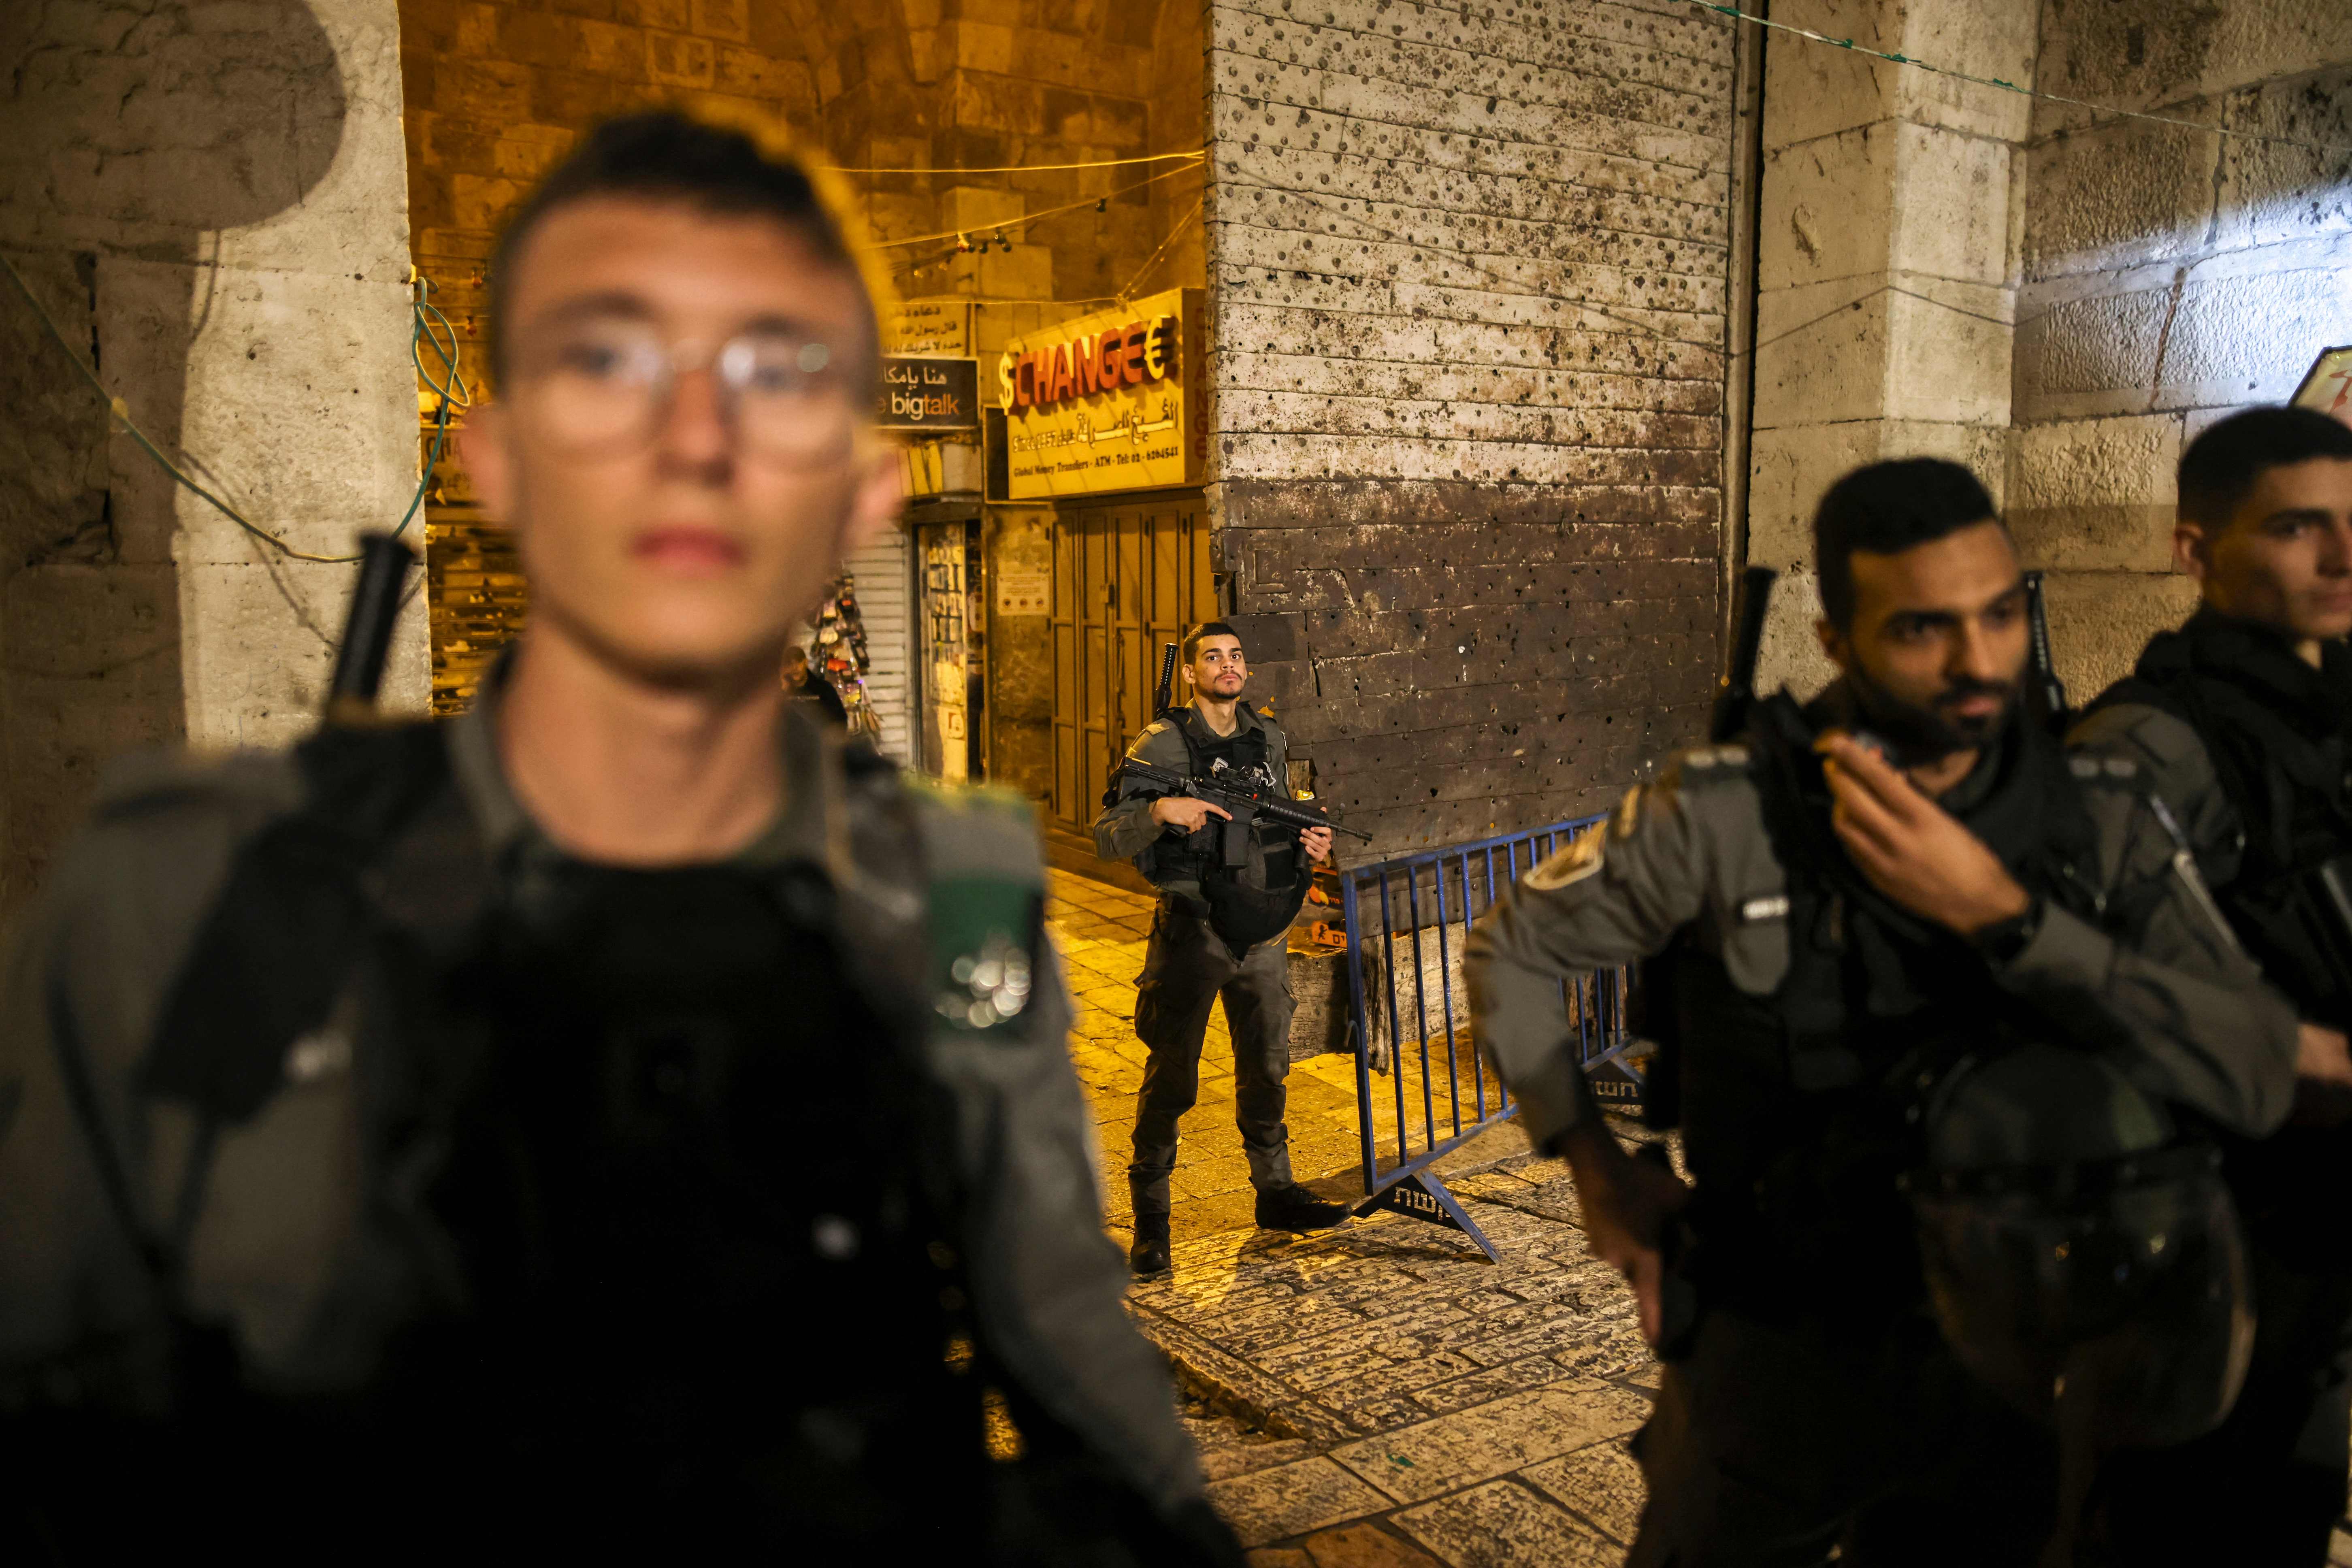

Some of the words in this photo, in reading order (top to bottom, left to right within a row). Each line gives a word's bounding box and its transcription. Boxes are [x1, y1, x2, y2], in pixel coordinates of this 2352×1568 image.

[883, 366, 919, 390] بإمكا
[923, 366, 948, 385] هنا
[892, 392, 960, 421] bigtalk
[1095, 455, 1111, 468] ATM
